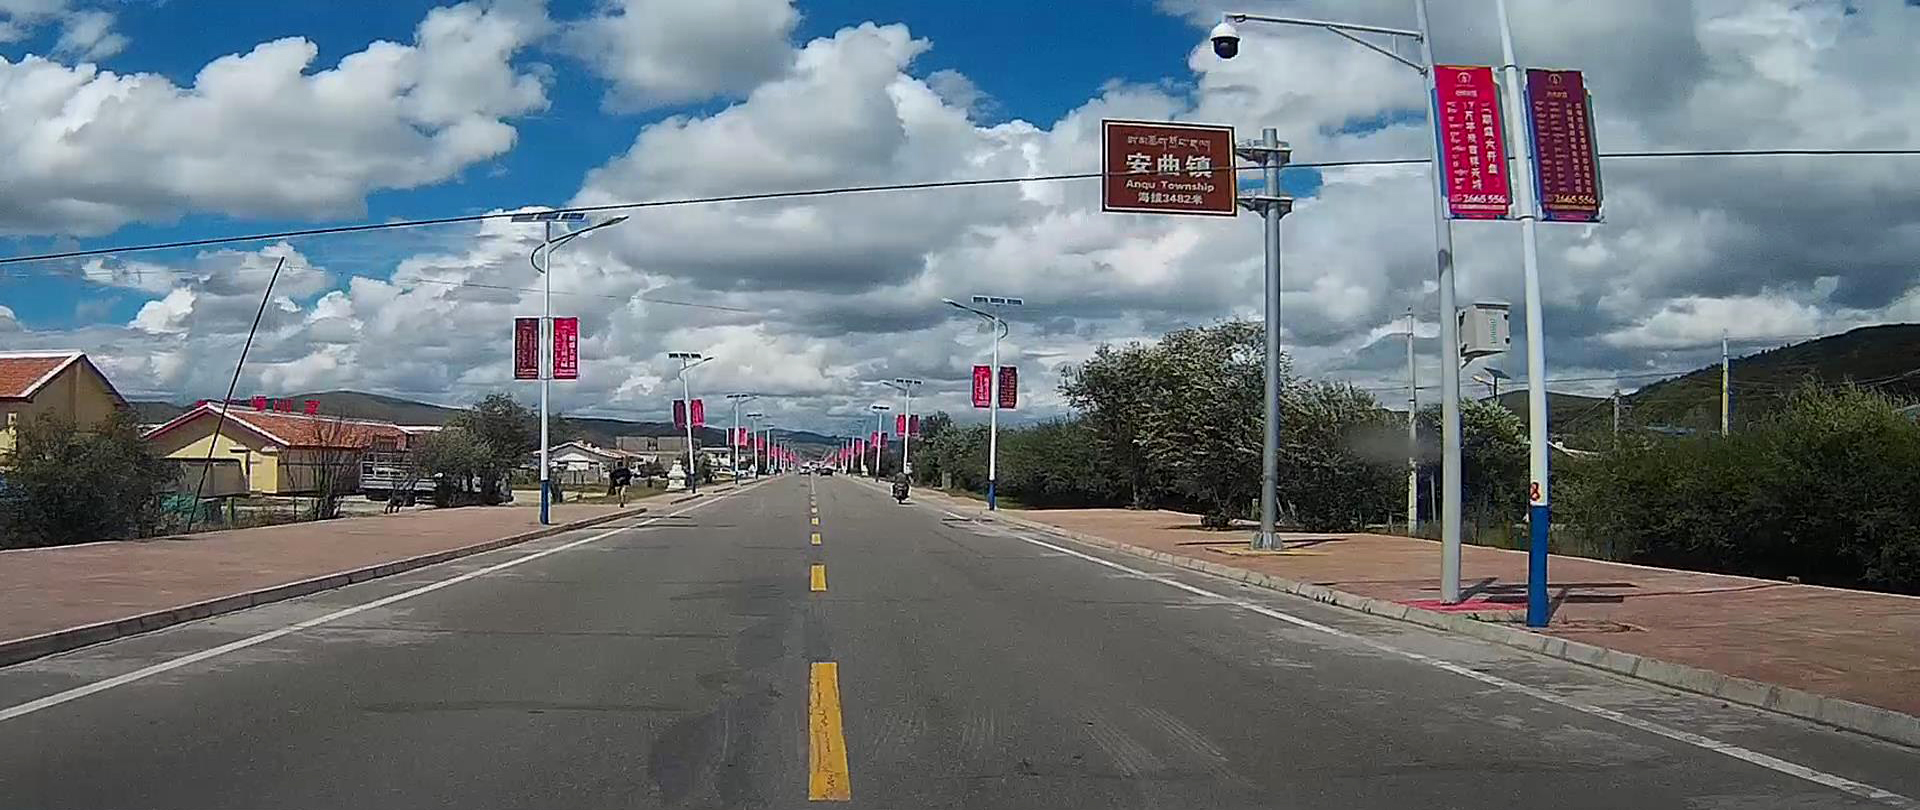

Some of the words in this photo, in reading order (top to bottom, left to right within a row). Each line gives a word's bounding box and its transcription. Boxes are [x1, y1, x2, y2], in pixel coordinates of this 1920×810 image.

[1126, 152, 1212, 178] 安曲镇
[1126, 179, 1156, 191] Anqu
[1161, 181, 1215, 193] Township
[1138, 191, 1203, 205] 海拔3482米
